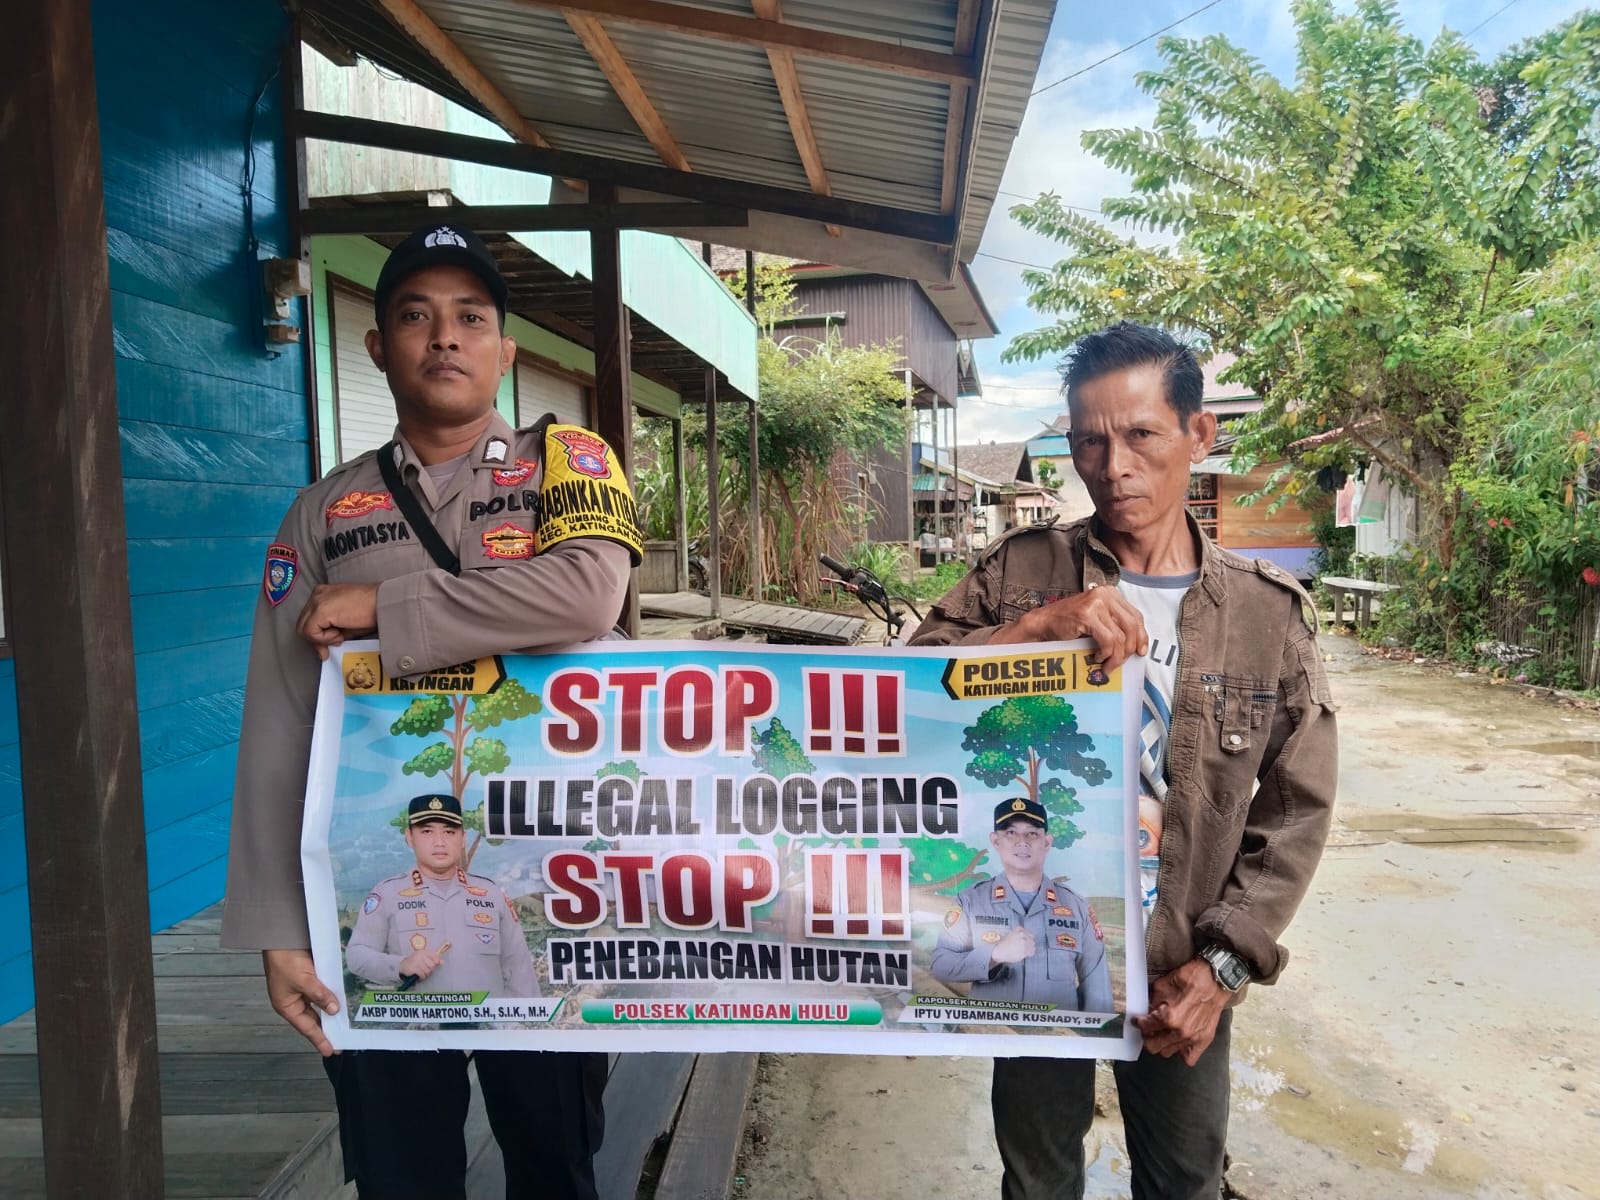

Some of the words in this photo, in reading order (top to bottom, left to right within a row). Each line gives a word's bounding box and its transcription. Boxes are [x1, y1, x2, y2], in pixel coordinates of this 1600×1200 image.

[469, 490, 539, 521] POLR
[561, 514, 609, 524] TUMBANG
[569, 521, 630, 539] KATINGAN
[323, 521, 410, 561] MONTASYA
[963, 657, 1065, 682] POLSEK
[964, 681, 1029, 697] KATINGAN
[1032, 679, 1066, 693] HULU
[547, 669, 774, 753] STOP
[487, 778, 699, 836] ILLEGAL
[715, 776, 959, 836] LOGGING
[547, 853, 773, 929] STOP
[397, 900, 427, 911] DODIK
[466, 899, 495, 909] POLRI
[1048, 918, 1080, 930] POLRI
[550, 940, 781, 980] PENEBANGAN
[789, 945, 908, 987] HUTAN
[374, 993, 422, 1003] KAPOLRES
[424, 993, 471, 1003] KATINGAN
[917, 997, 968, 1006] KAPOLSEK
[969, 1000, 1020, 1010] KATINGAN
[1021, 1003, 1048, 1011] HULU
[361, 1006, 387, 1018] AKBP
[389, 1007, 419, 1018] DODIK
[422, 1007, 472, 1020] HARTONO,
[473, 1007, 496, 1020] S.H.,
[498, 1006, 526, 1019] S.I.K.,
[528, 1006, 549, 1018] M.H.
[613, 1003, 688, 1019] POLSEK
[694, 1003, 791, 1020] KATINGAN
[798, 1004, 848, 1020] HULU
[914, 1008, 941, 1019] IPTU
[945, 1010, 1019, 1021] YUBAMBANG
[1022, 1013, 1081, 1025] KUSNADY,
[1084, 1017, 1101, 1025] SH
